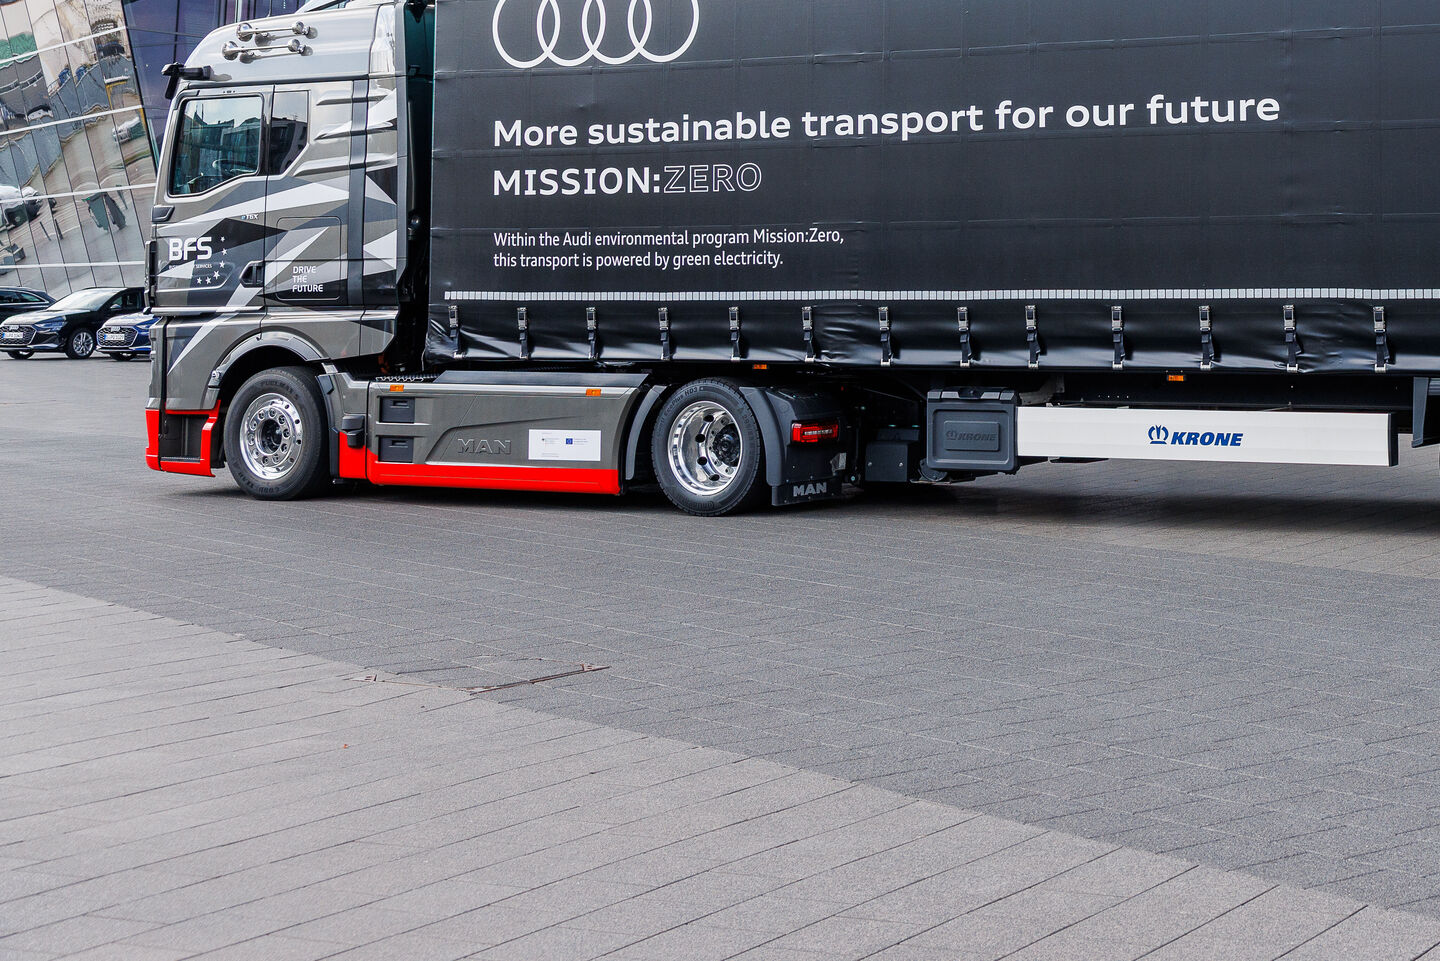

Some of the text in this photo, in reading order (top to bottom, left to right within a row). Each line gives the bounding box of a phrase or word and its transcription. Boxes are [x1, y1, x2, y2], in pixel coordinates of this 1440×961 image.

[495, 94, 1280, 147] More sustainable transport for our future
[493, 162, 763, 196] MISSION:ZERO
[494, 228, 844, 248] Within the Audi environmental program Mission:Zero,
[169, 237, 213, 261] BFS
[494, 250, 783, 270] this transport is powered by green electricity.
[293, 266, 317, 274] DRIVE
[293, 275, 308, 283] THE
[293, 284, 324, 293] FUTURE
[457, 438, 511, 455] MAN
[1171, 431, 1244, 447] KRONE
[793, 482, 827, 497] MAN
